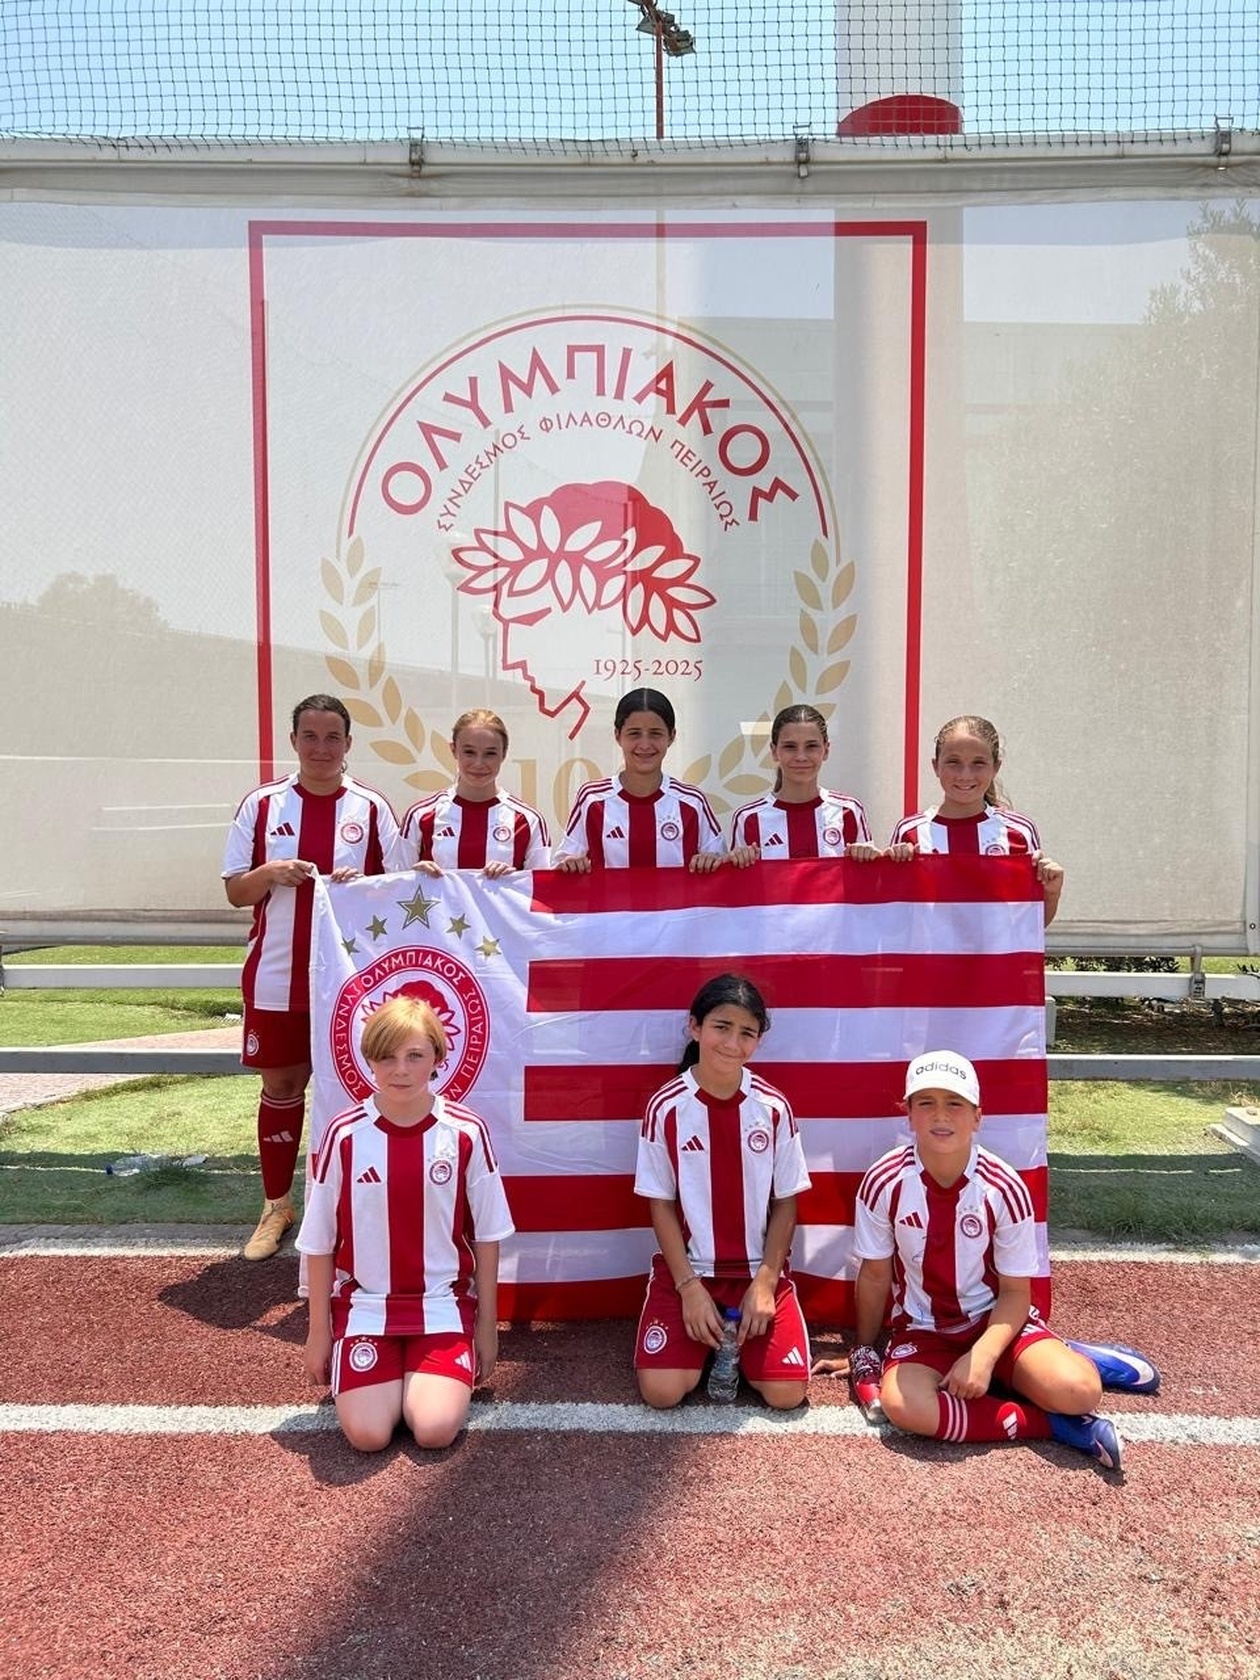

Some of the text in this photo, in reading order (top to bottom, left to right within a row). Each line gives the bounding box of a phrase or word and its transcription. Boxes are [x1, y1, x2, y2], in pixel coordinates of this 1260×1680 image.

[381, 344, 800, 522] ΟΛΥΜΠΙΑΚΟΣ
[437, 411, 740, 532] ΣΥΝΔΕΣΜΟΣ ΦΙΛΑΘΛΩΝ ΠΕΙΡΑΙΩΣ
[594, 659, 703, 682] 1925-2025
[361, 951, 466, 988] ΟΛΥΜΠΙΑΚΟΣ
[335, 982, 485, 1095] ΣΥΝΔΕΣΜΟΣ ΠΕΙΡΑΙΩΣ
[916, 1062, 967, 1080] adidas
